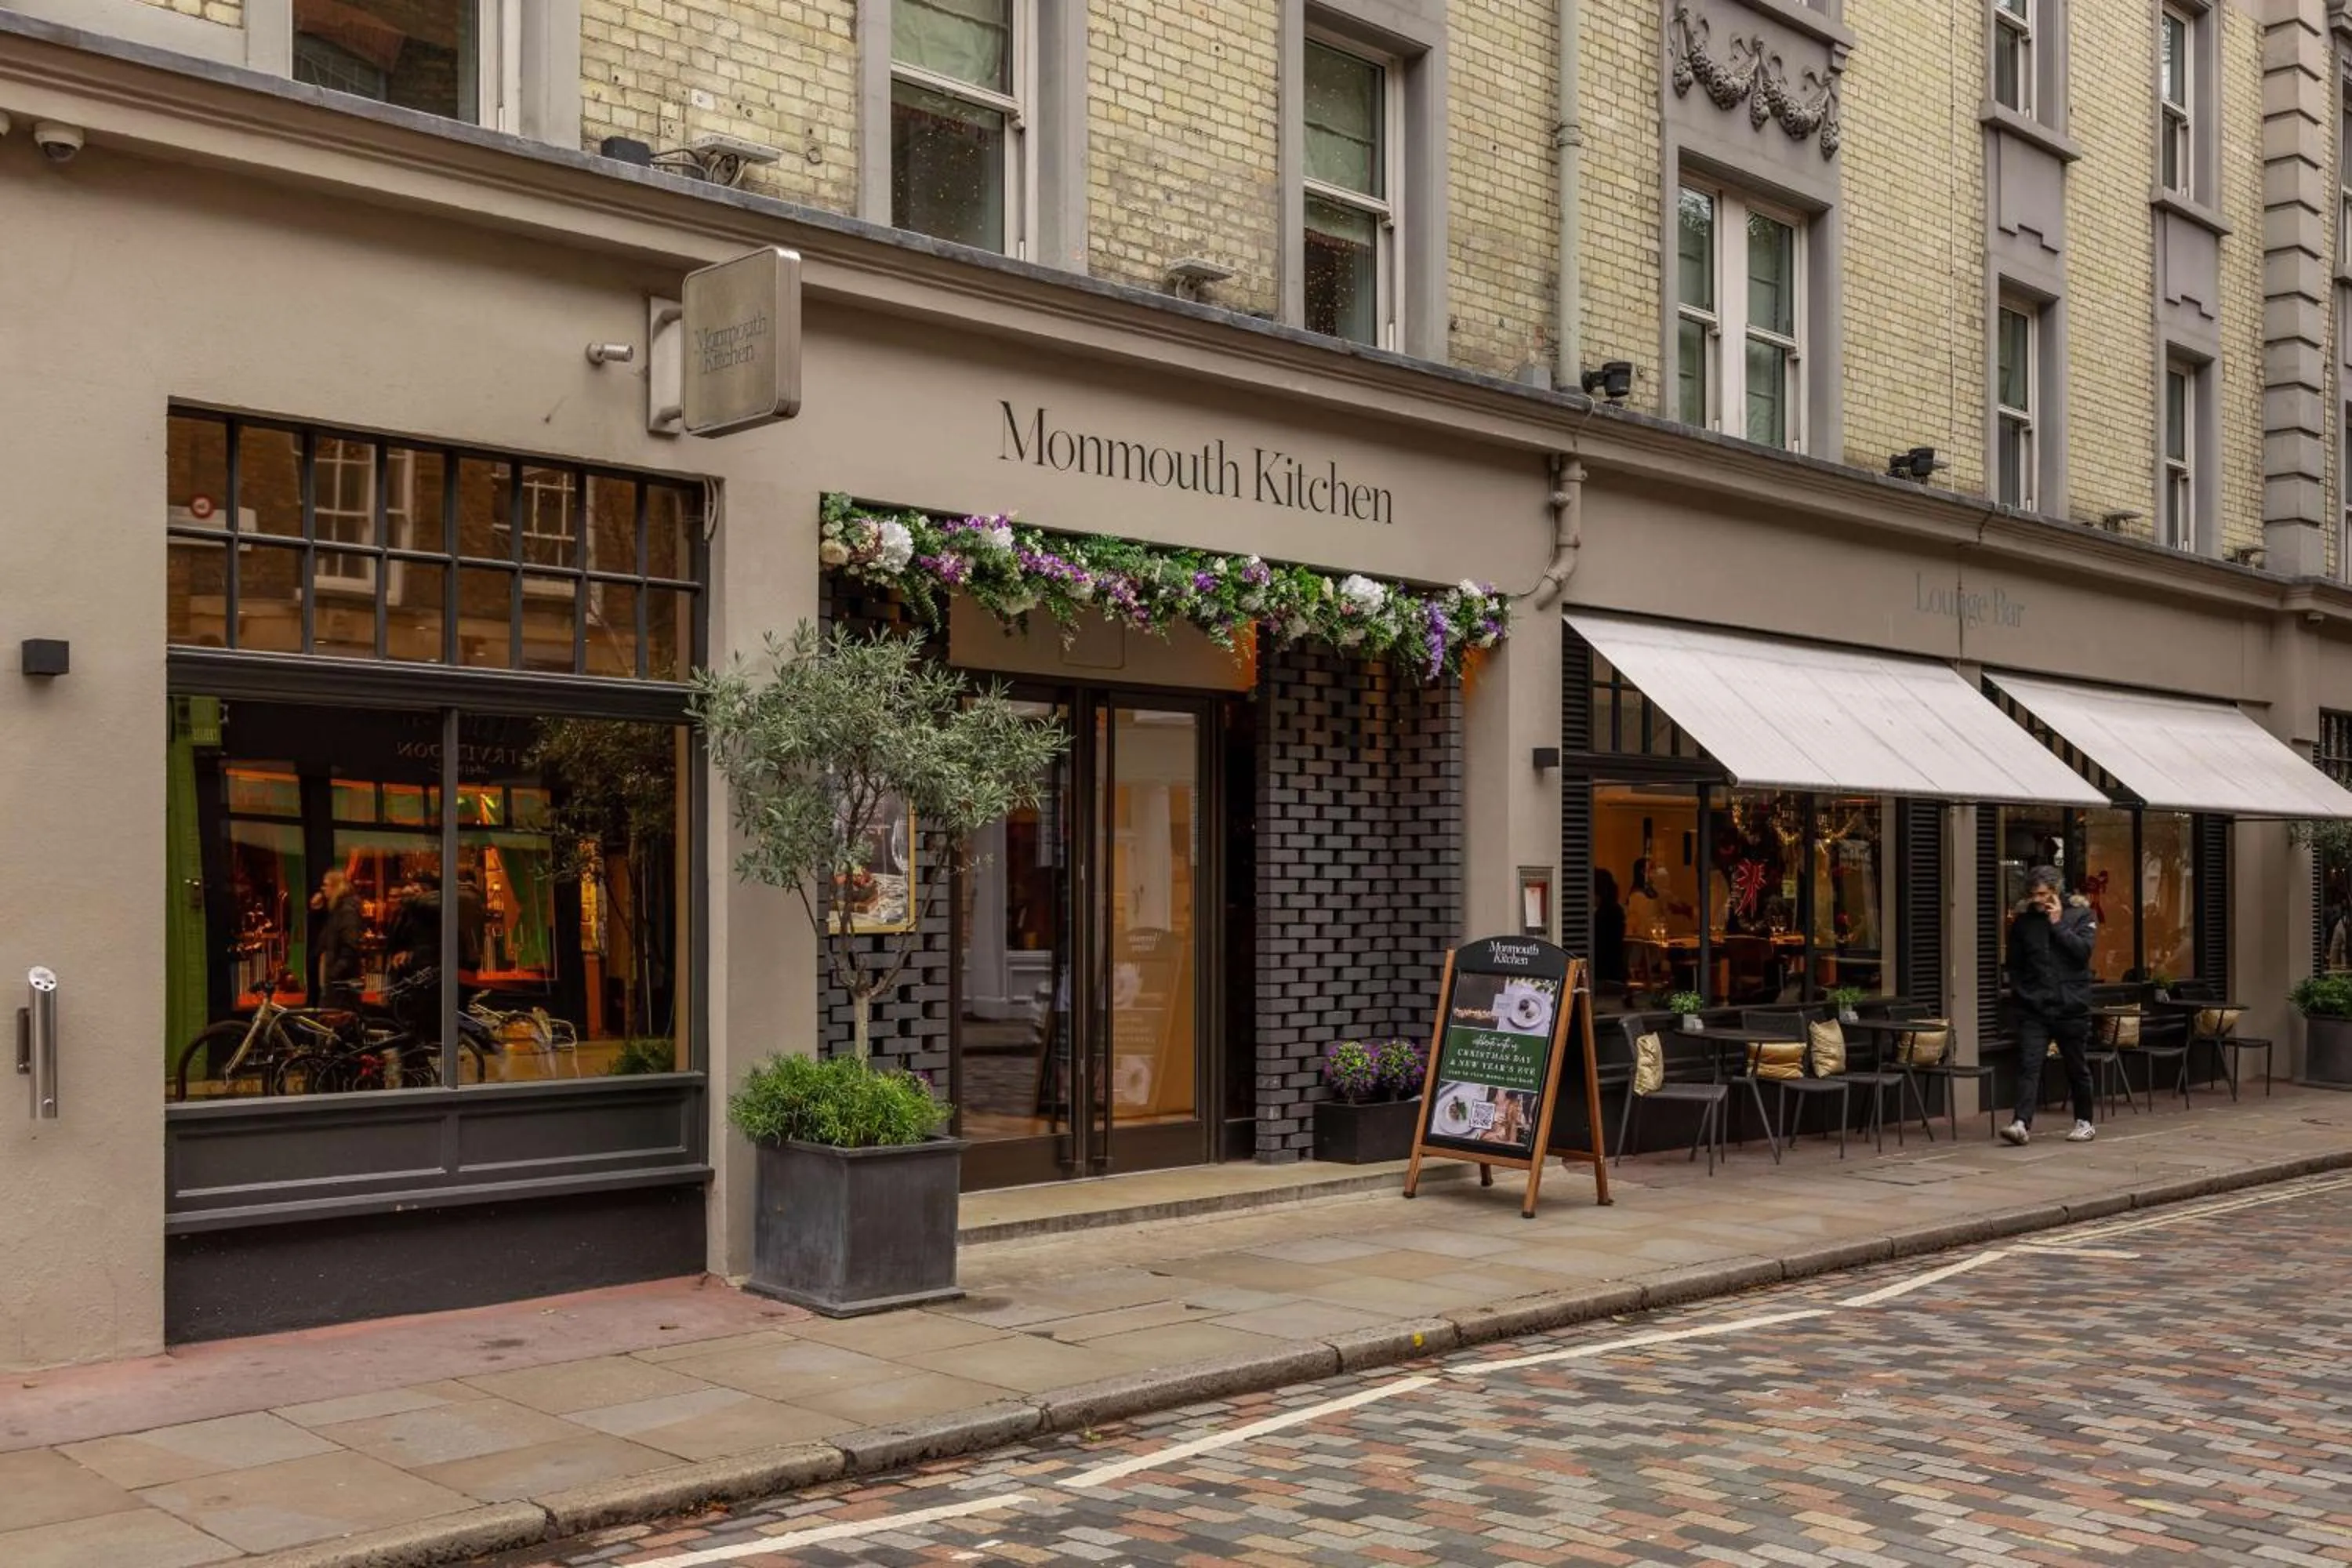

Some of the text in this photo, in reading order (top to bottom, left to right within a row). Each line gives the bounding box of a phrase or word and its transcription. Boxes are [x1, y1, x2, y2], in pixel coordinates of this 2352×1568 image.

[701, 341, 754, 376] Kitchen
[998, 400, 1393, 524] Monmouth Kitchen
[1915, 572, 2026, 630] Lounge Bar
[1489, 940, 1540, 956] Monmouth
[1494, 951, 1529, 966] Kitchen
[1457, 1048, 1533, 1065] CHRISTMAS DAY
[1457, 1059, 1479, 1068] NEW
[1483, 1062, 1515, 1073] YEAR'S
[1517, 1066, 1536, 1076] EVE
